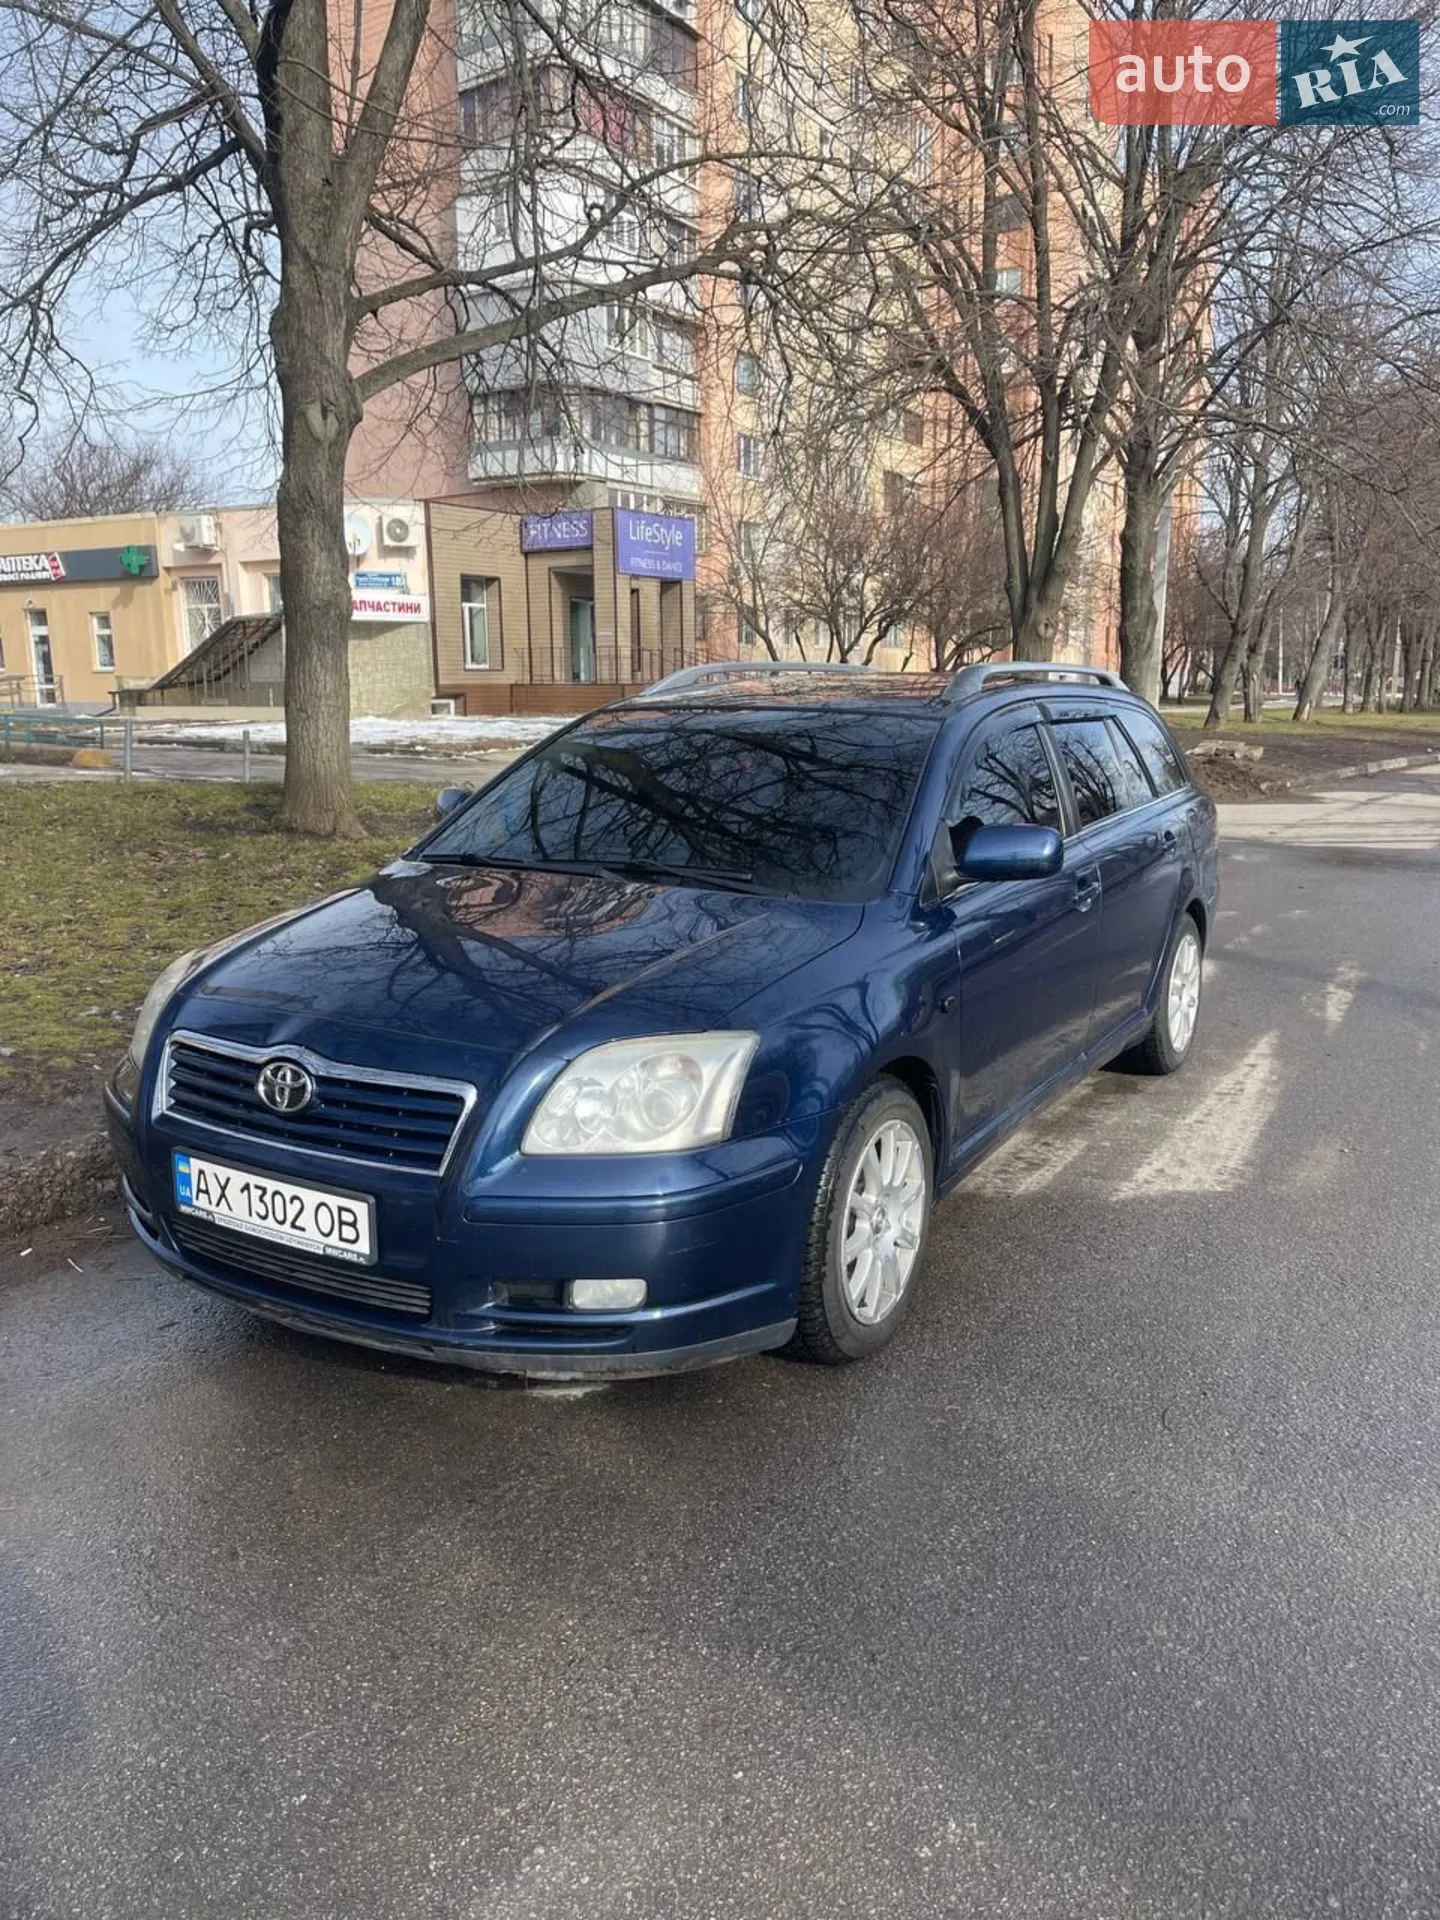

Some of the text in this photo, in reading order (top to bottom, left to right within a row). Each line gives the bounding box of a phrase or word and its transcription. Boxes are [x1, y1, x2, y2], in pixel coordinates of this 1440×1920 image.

[529, 520, 589, 541] FITNESS
[629, 519, 684, 550] LifeStyle
[351, 599, 421, 614] АПЧАСТИНИ
[179, 1185, 192, 1198] UA
[195, 1168, 360, 1245] AX 1302 OB
